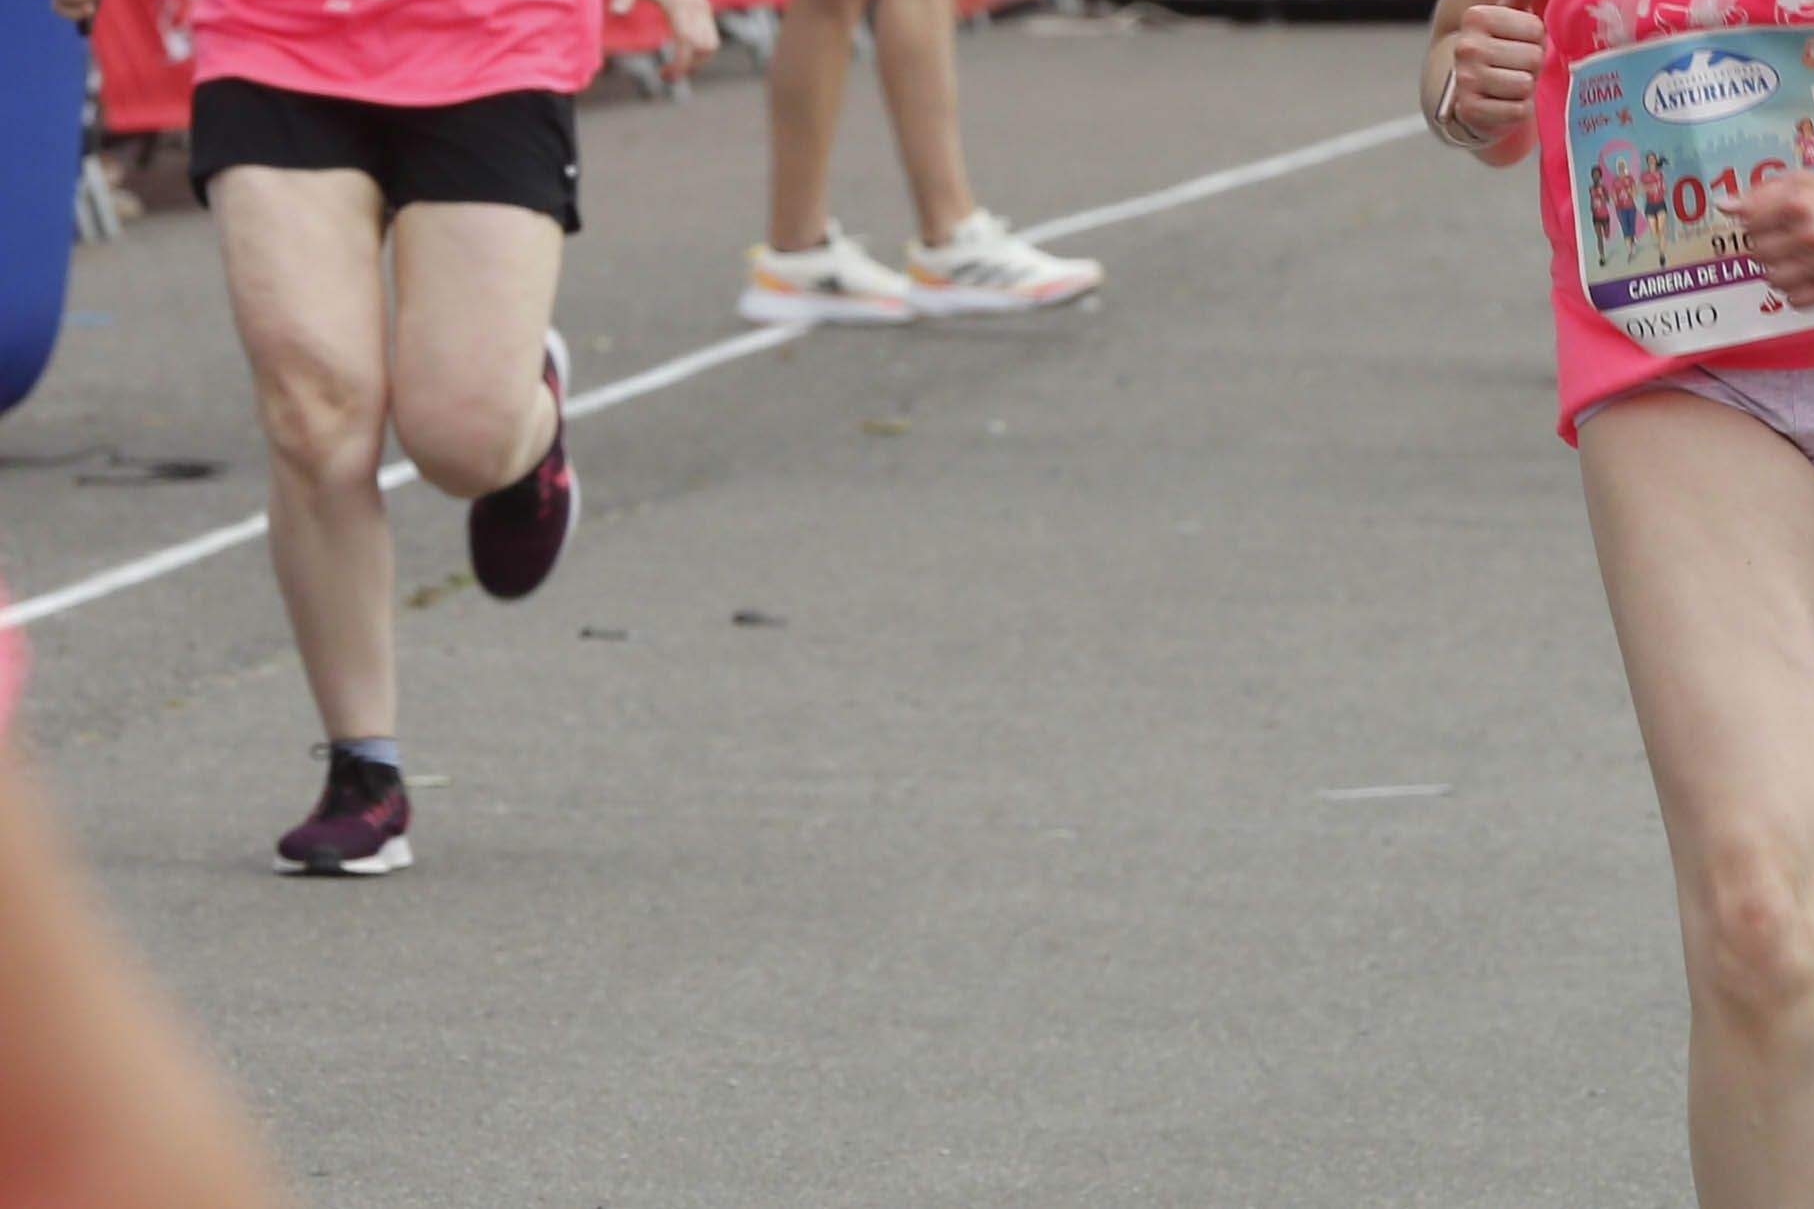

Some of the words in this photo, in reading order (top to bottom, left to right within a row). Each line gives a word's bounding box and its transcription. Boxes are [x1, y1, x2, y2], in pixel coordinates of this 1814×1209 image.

[1653, 74, 1771, 113] ASTURIANA
[1628, 269, 1695, 300] CARRERA
[1697, 265, 1719, 286] DE
[1721, 259, 1745, 281] LA
[1626, 302, 1718, 340] OYSHO
